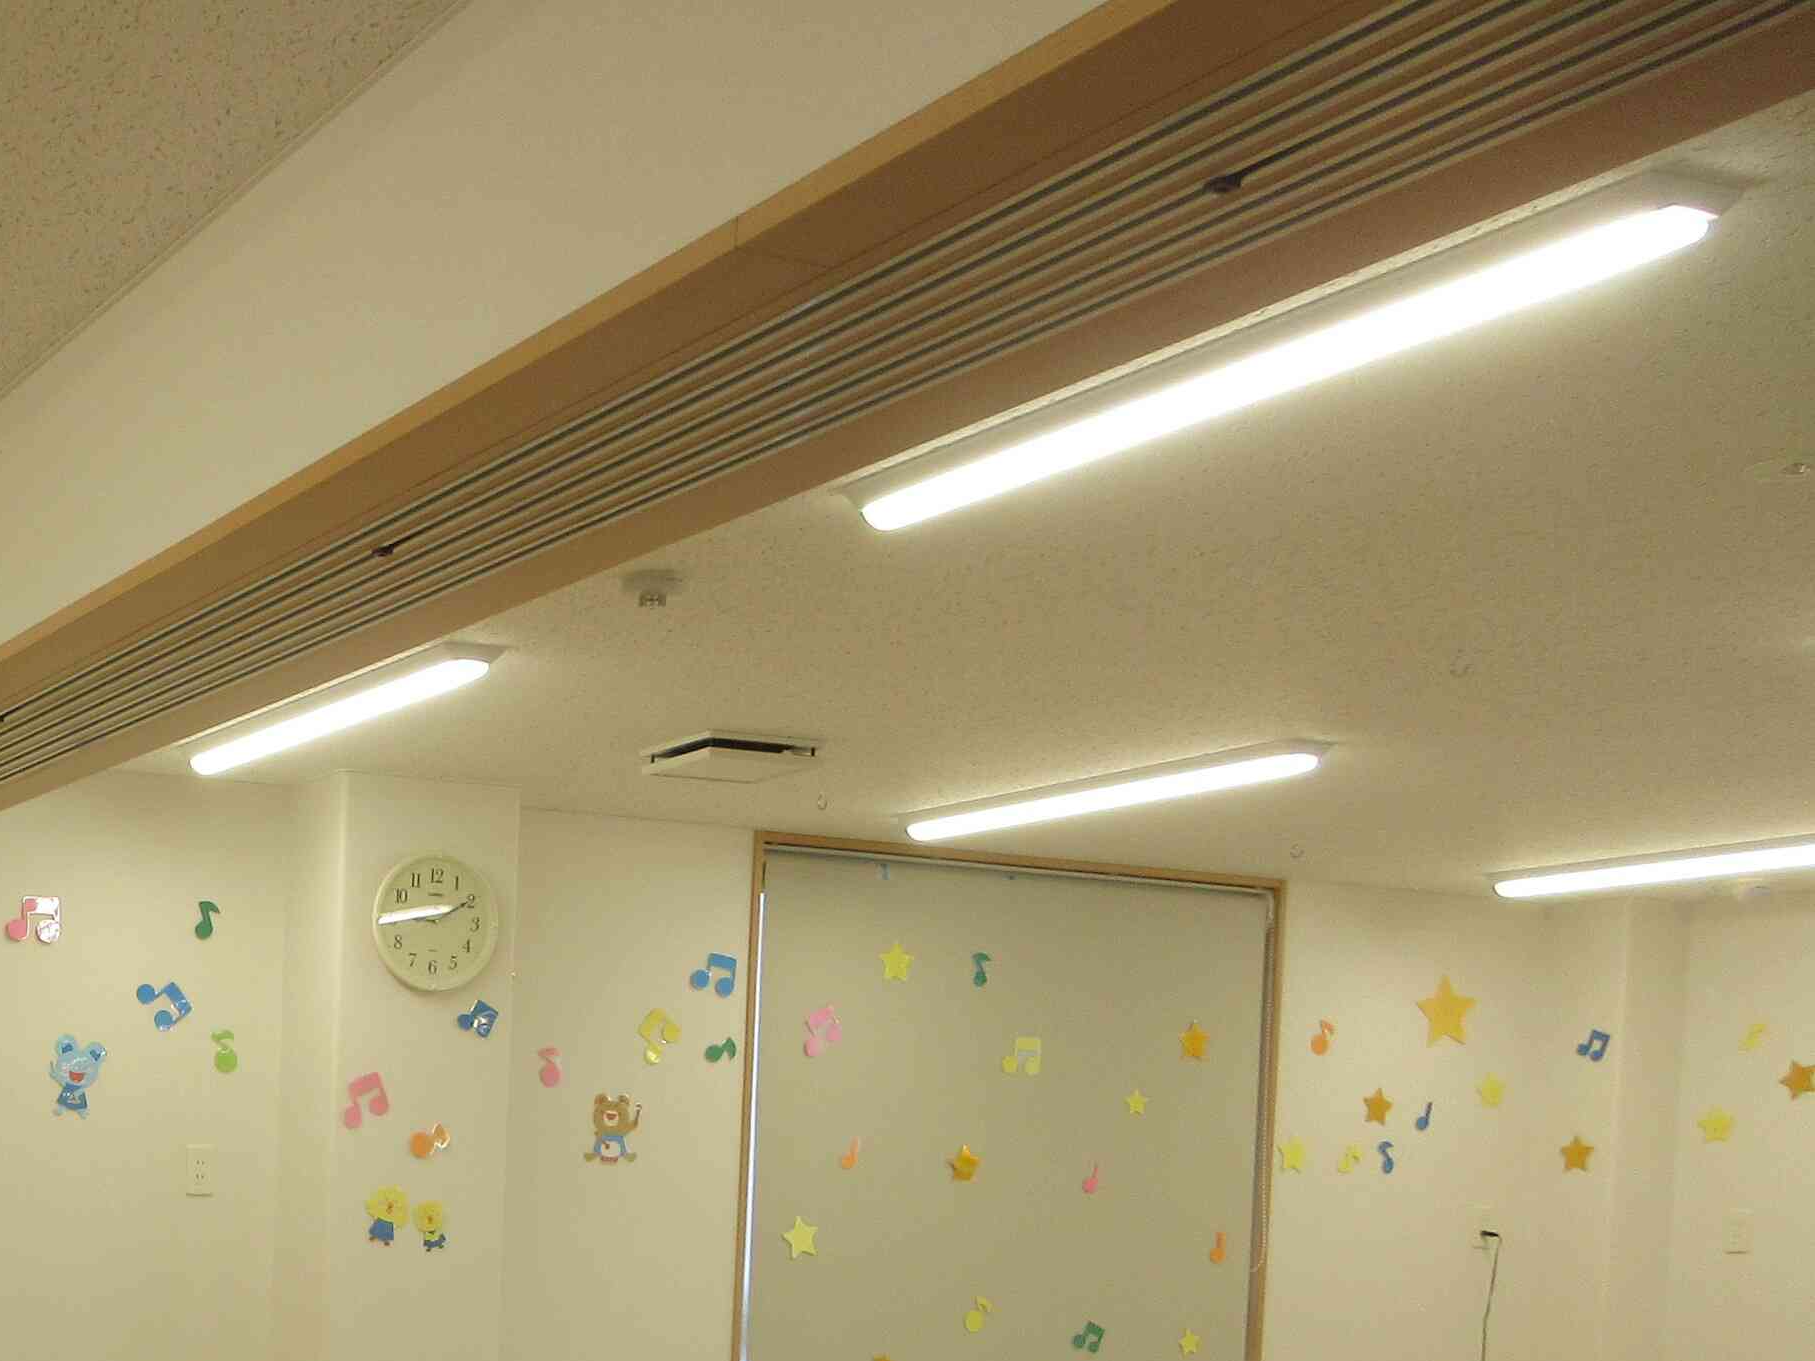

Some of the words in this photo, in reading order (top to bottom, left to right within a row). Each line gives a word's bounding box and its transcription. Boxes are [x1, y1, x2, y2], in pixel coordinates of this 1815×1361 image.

[411, 873, 420, 888] 11
[430, 868, 443, 883] 12
[395, 888, 407, 904] 10
[467, 894, 475, 908] 2
[470, 917, 479, 932] 3
[394, 935, 402, 949] 8
[462, 939, 471, 953] 4
[408, 953, 417, 967] 7
[428, 960, 437, 974] 6
[449, 956, 458, 970] 5
